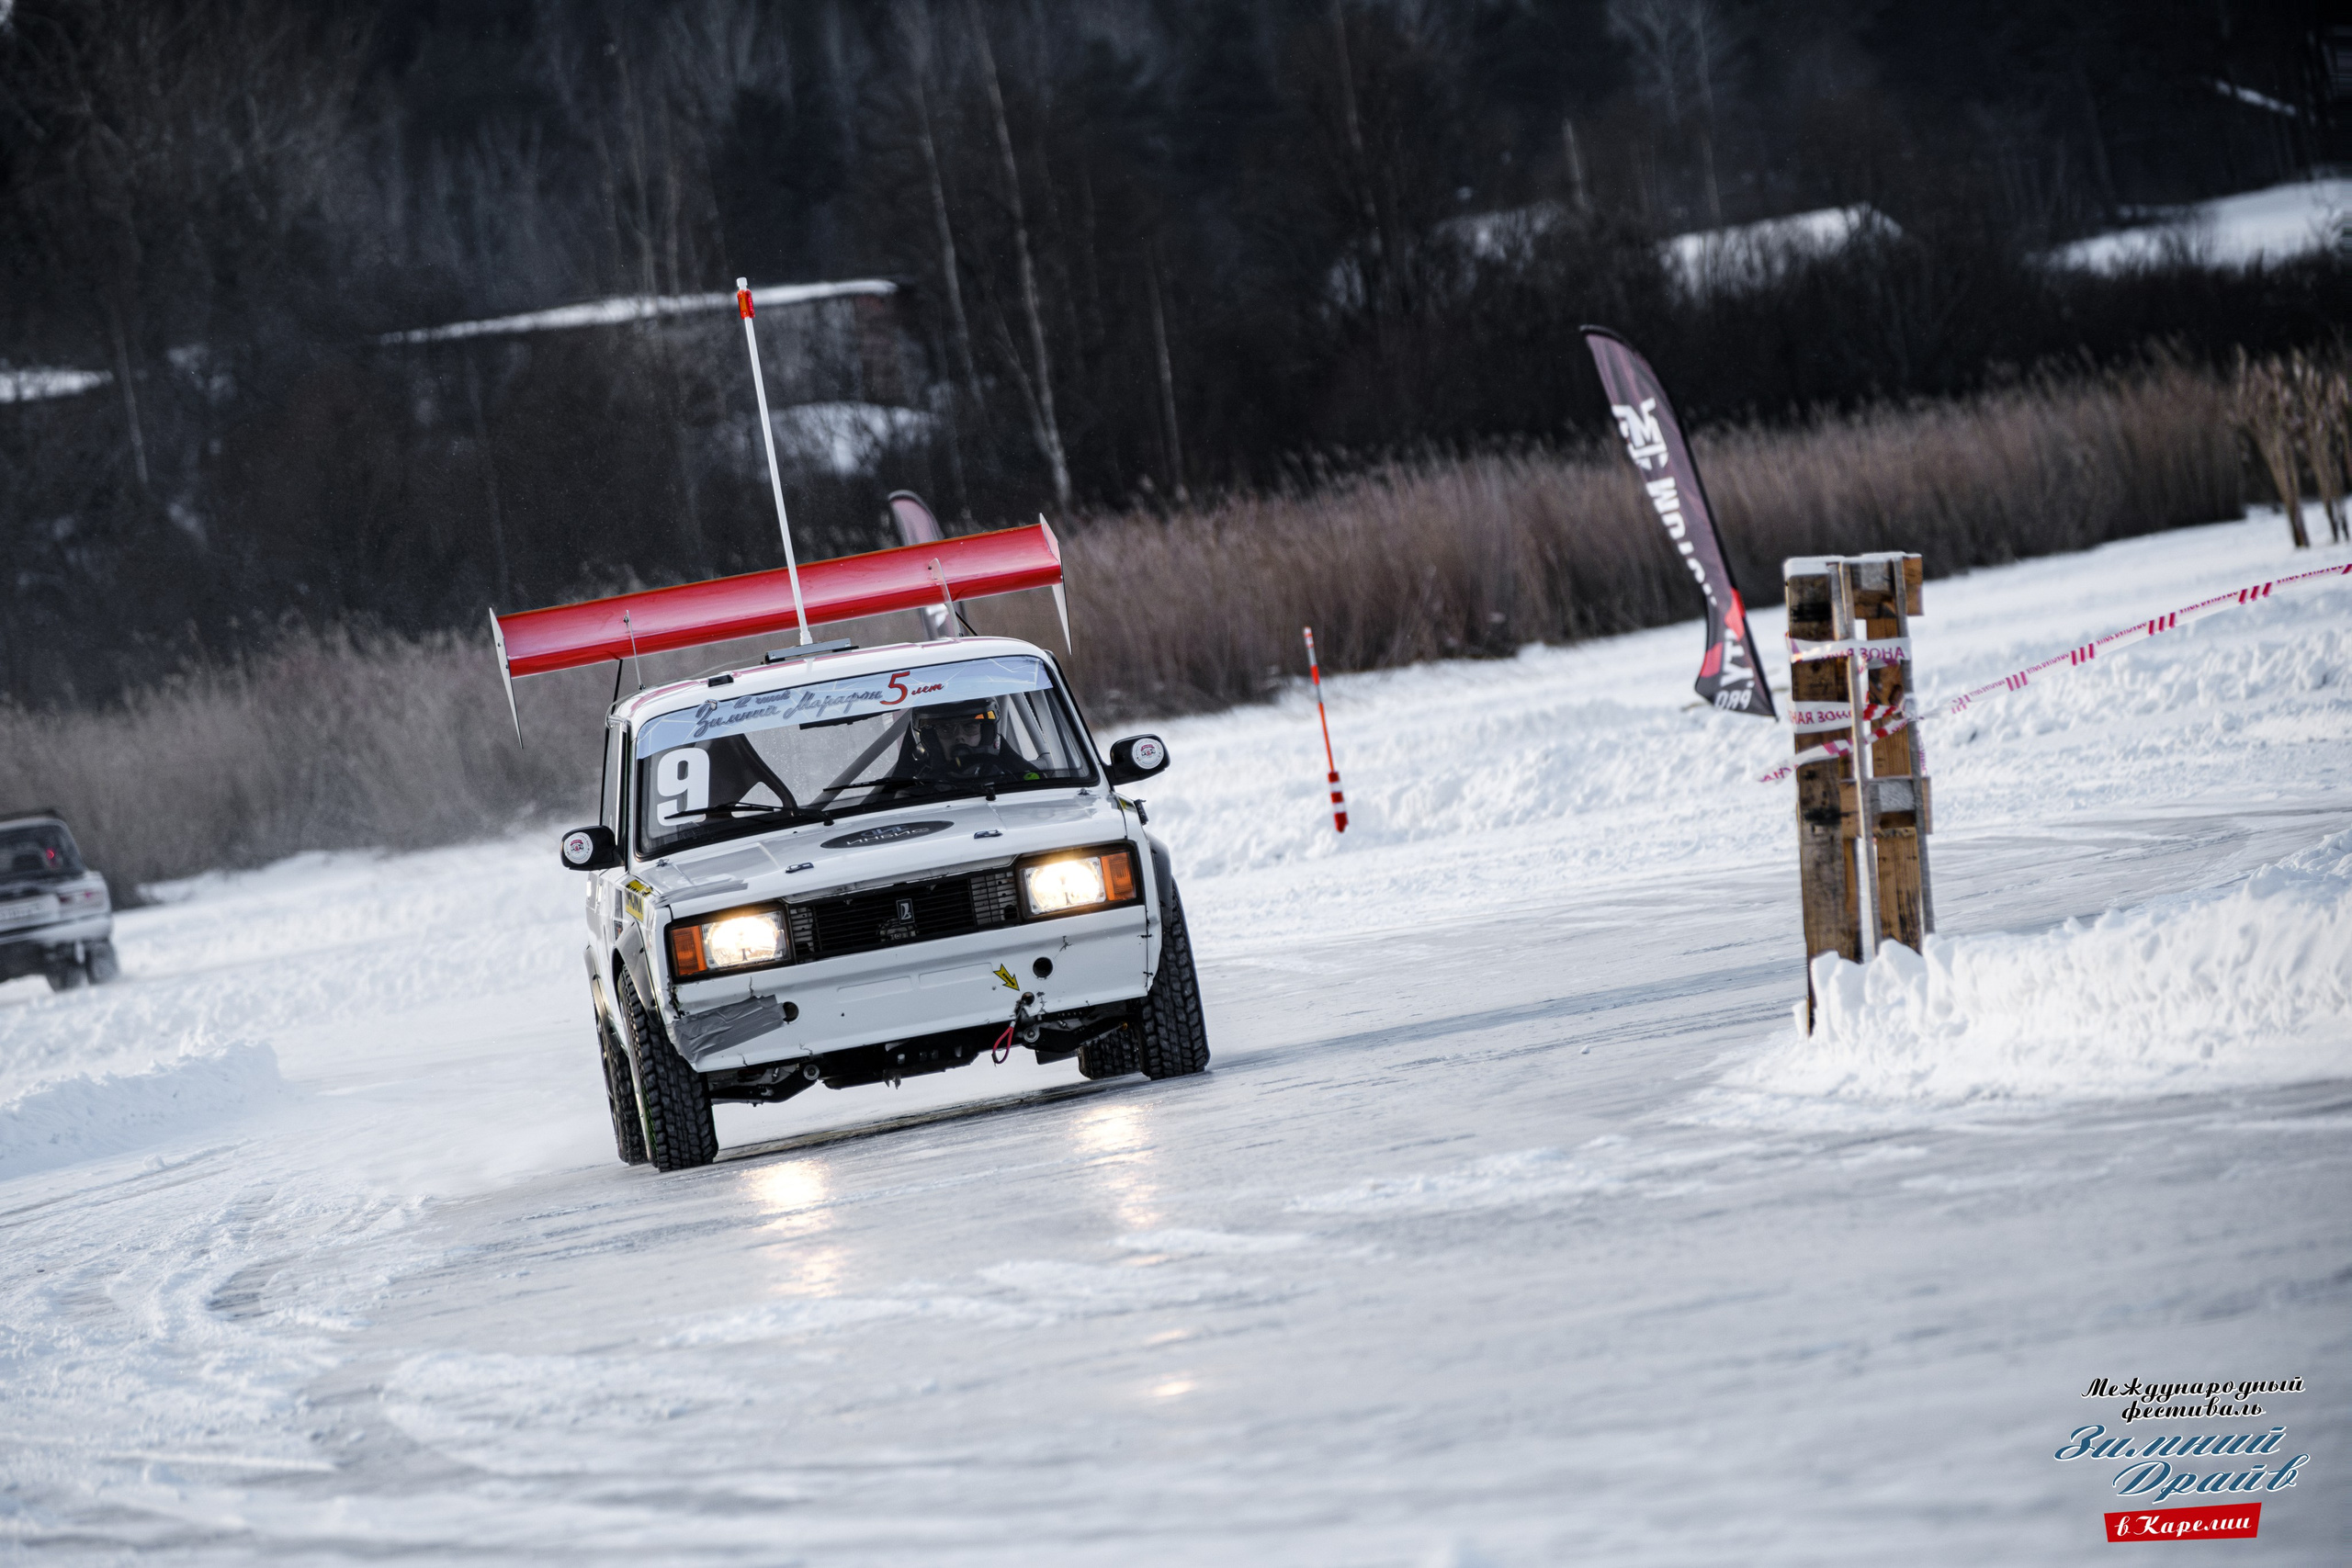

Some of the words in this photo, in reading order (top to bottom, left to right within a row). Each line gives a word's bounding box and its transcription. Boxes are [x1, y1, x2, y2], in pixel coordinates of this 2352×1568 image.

[694, 701, 781, 738] Зимний
[783, 691, 883, 720] Марафон
[879, 671, 910, 705] 5
[910, 684, 944, 696] лет
[656, 747, 710, 826] 9
